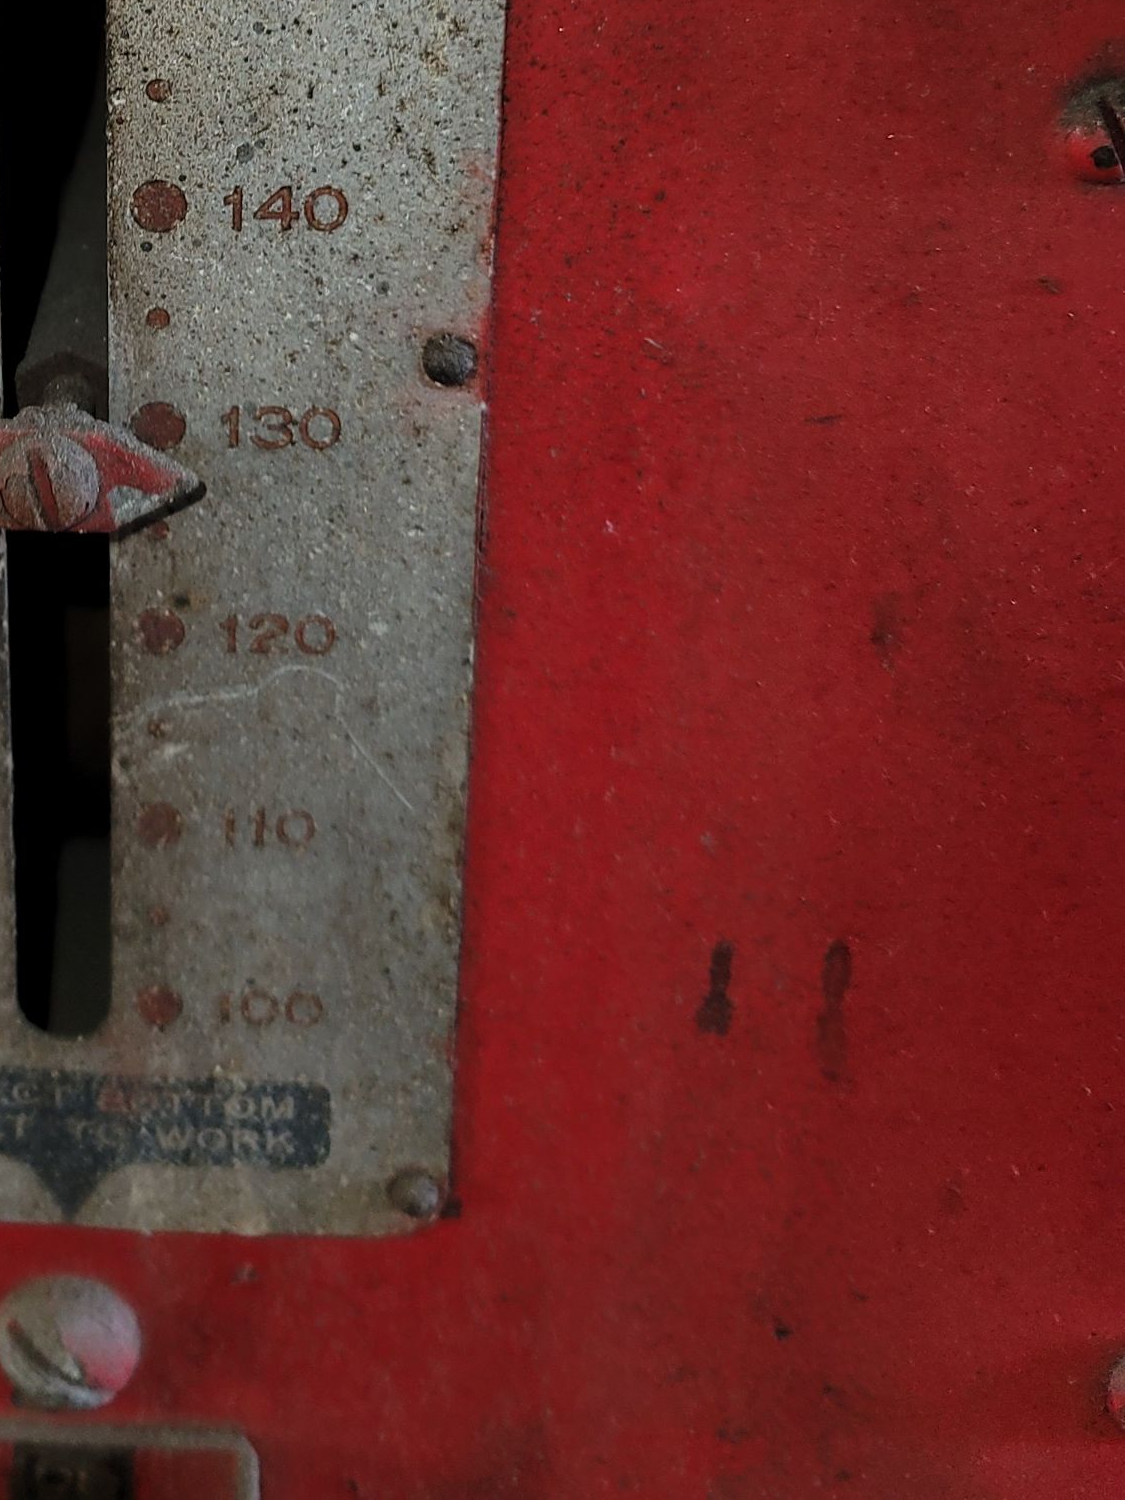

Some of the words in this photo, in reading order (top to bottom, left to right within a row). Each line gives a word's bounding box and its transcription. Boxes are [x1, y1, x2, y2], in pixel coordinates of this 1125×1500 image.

[223, 184, 349, 234] 140
[220, 405, 342, 452] 130
[219, 613, 338, 656] 120
[221, 806, 317, 850] 110
[217, 987, 324, 1028] 100
[156, 1123, 296, 1154] WORK
